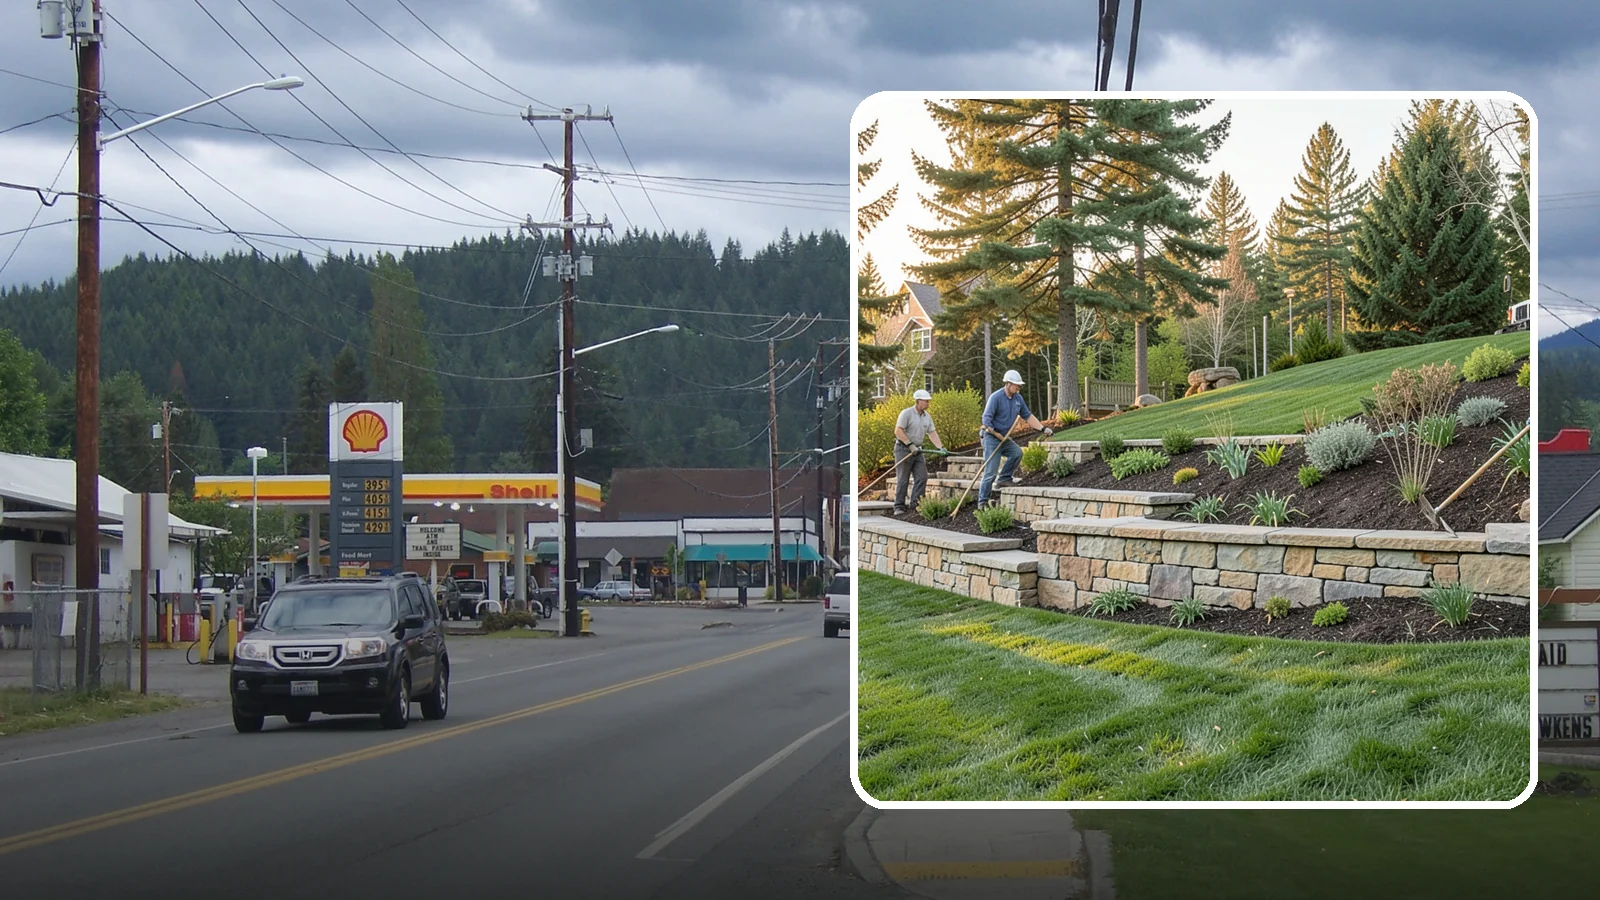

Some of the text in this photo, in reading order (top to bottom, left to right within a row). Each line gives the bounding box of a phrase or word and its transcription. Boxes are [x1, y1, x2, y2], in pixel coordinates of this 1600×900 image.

[366, 480, 384, 490] 395
[490, 484, 547, 499] Shell
[366, 494, 384, 504] 405
[366, 508, 384, 518] 415
[366, 522, 384, 532] 429
[1538, 642, 1567, 666] AID
